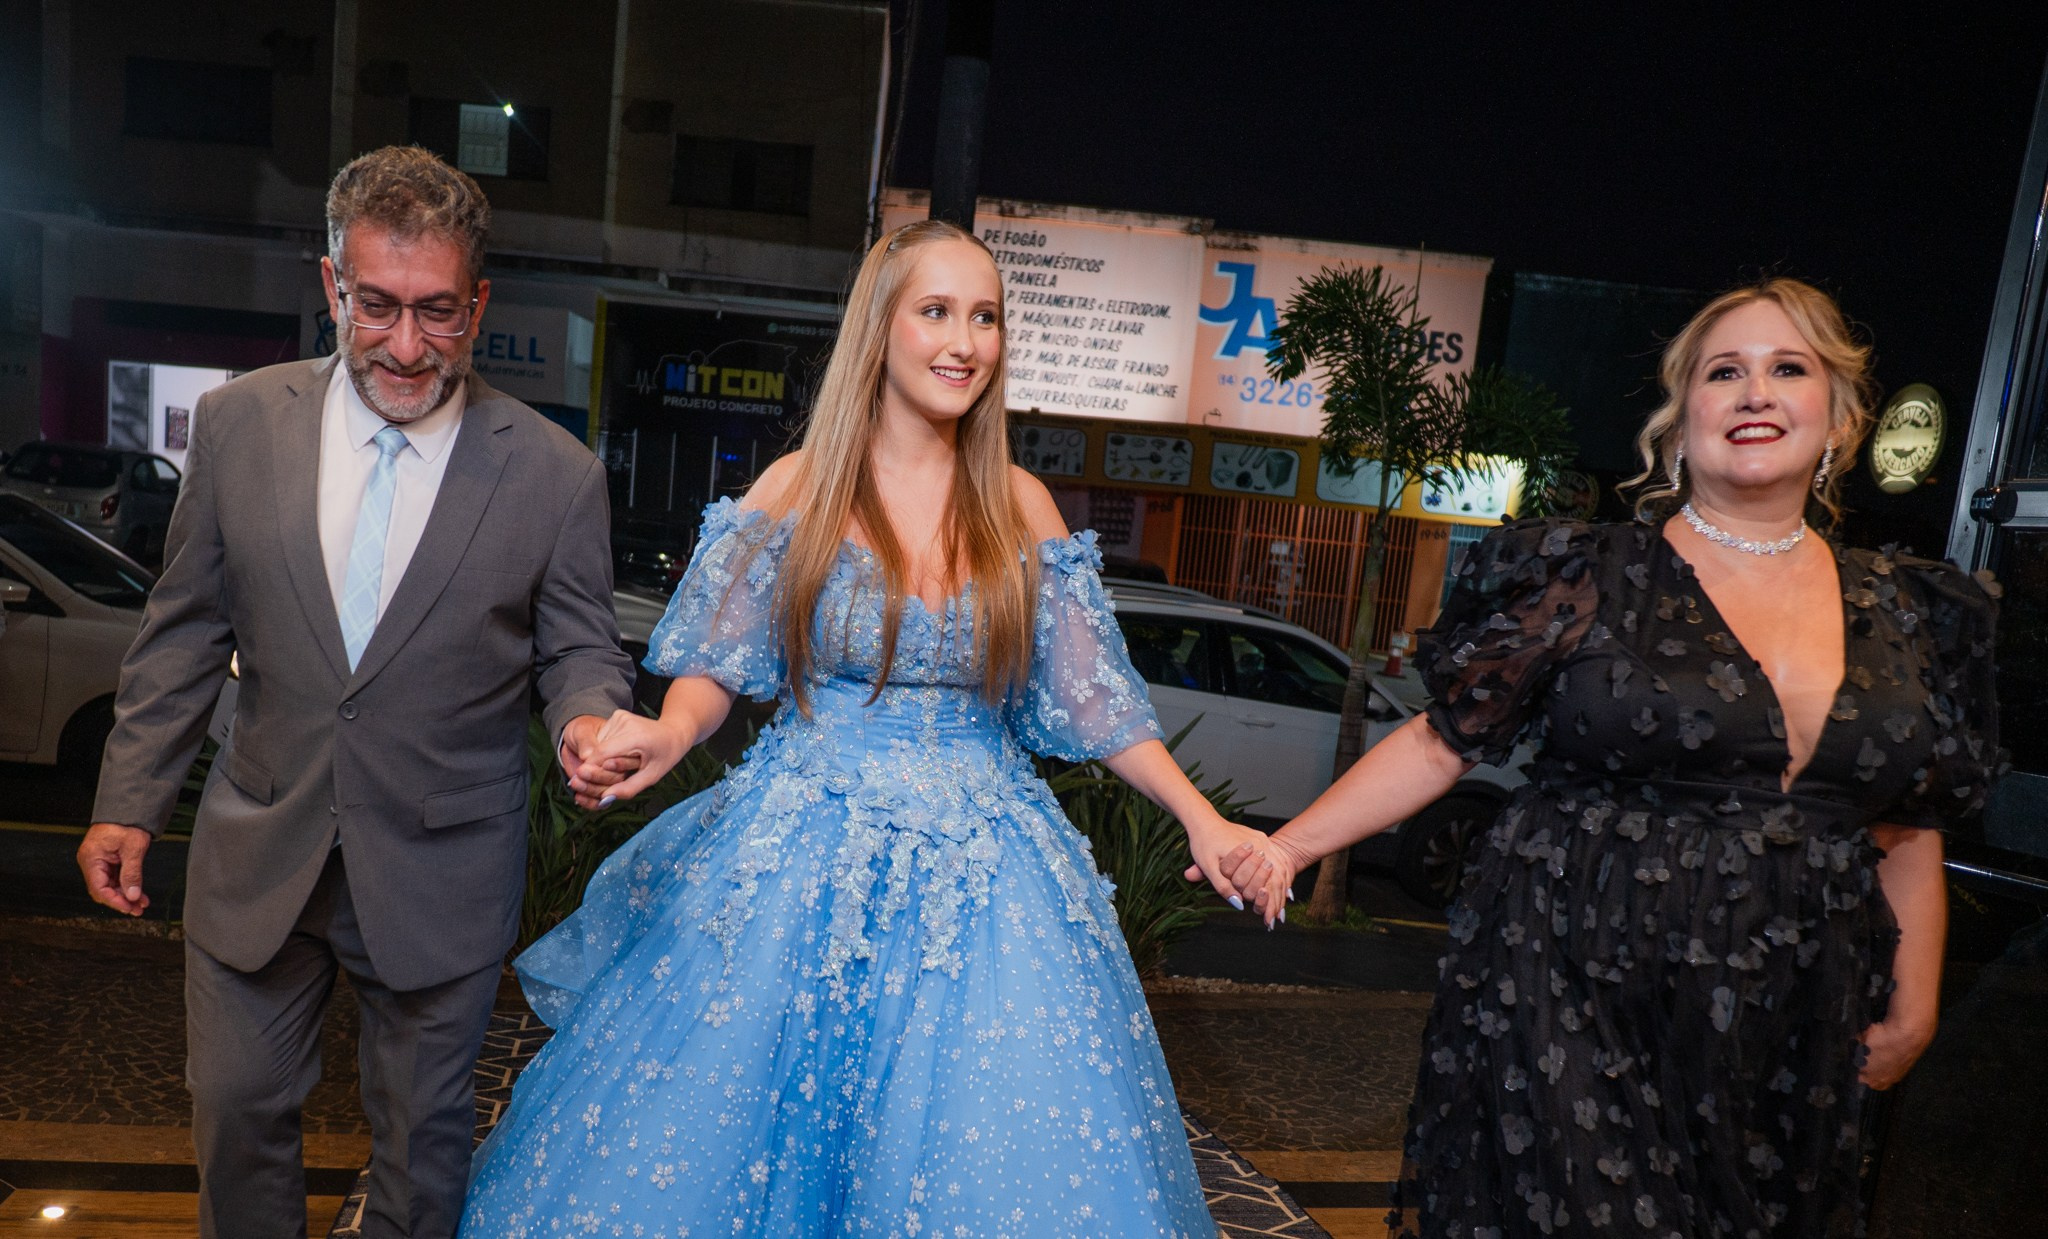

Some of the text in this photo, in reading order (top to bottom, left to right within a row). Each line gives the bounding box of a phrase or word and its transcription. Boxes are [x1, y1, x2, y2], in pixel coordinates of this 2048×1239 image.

[983, 229, 1047, 248] DE FOGÃO
[991, 250, 1105, 273] ETRODOMÉSTICOS
[1008, 270, 1058, 288] PANELA
[1018, 291, 1097, 311] FERRAMENTAS
[1198, 261, 1284, 363] JA
[1090, 317, 1108, 332] DE
[1107, 319, 1145, 336] LAVAR
[1018, 329, 1034, 343] DE
[1039, 332, 1122, 352] MICRO-ONDAS
[1066, 354, 1081, 367] DE
[1082, 356, 1118, 371] ASSAR
[1123, 360, 1169, 377] FRANGO
[1136, 381, 1178, 398] LANCHE
[1240, 377, 1325, 408] 3226-
[663, 395, 783, 416] PROJETO CONCRETO
